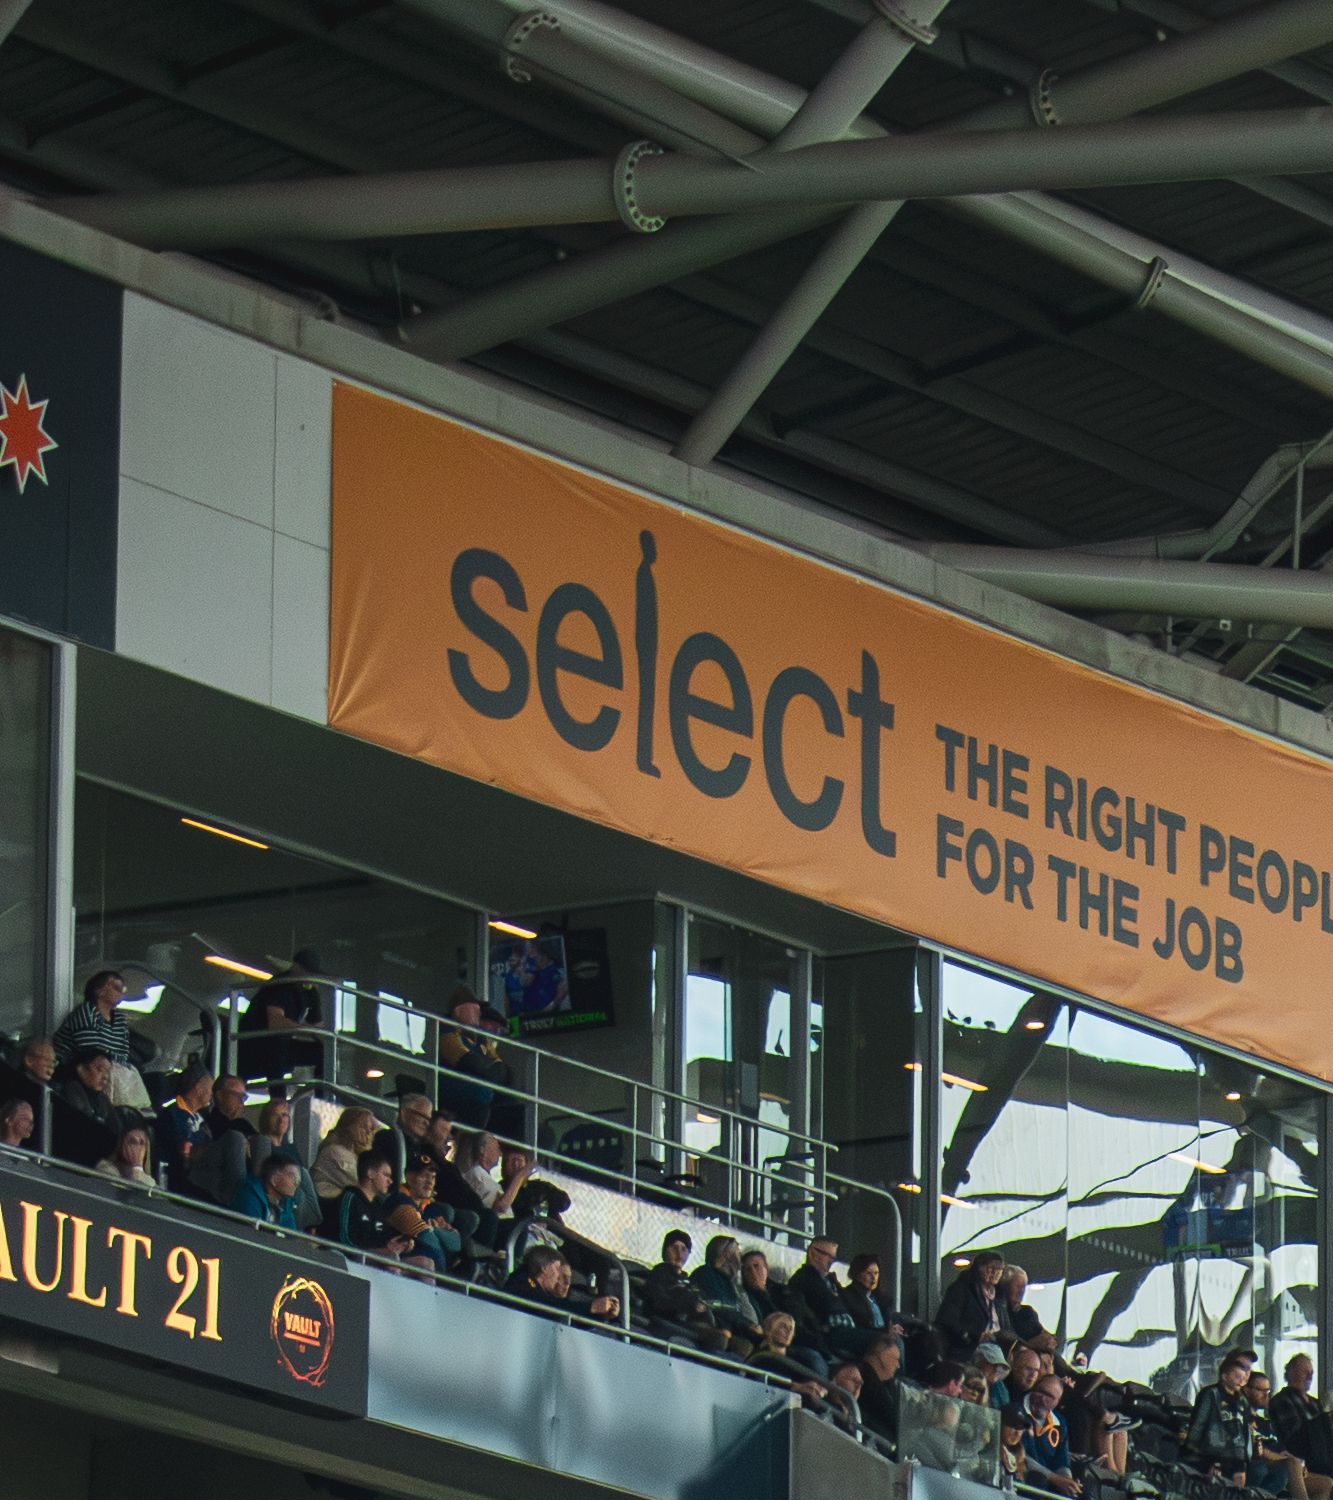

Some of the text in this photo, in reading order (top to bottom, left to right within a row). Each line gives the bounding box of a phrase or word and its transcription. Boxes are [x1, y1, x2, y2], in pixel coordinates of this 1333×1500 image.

[447, 530, 896, 858] select
[935, 723, 1029, 819] THE
[1045, 765, 1186, 874] RIGHT
[936, 813, 1244, 983] FOR THE JOB
[164, 1246, 223, 1341] 21
[284, 1311, 321, 1339] VAULT
